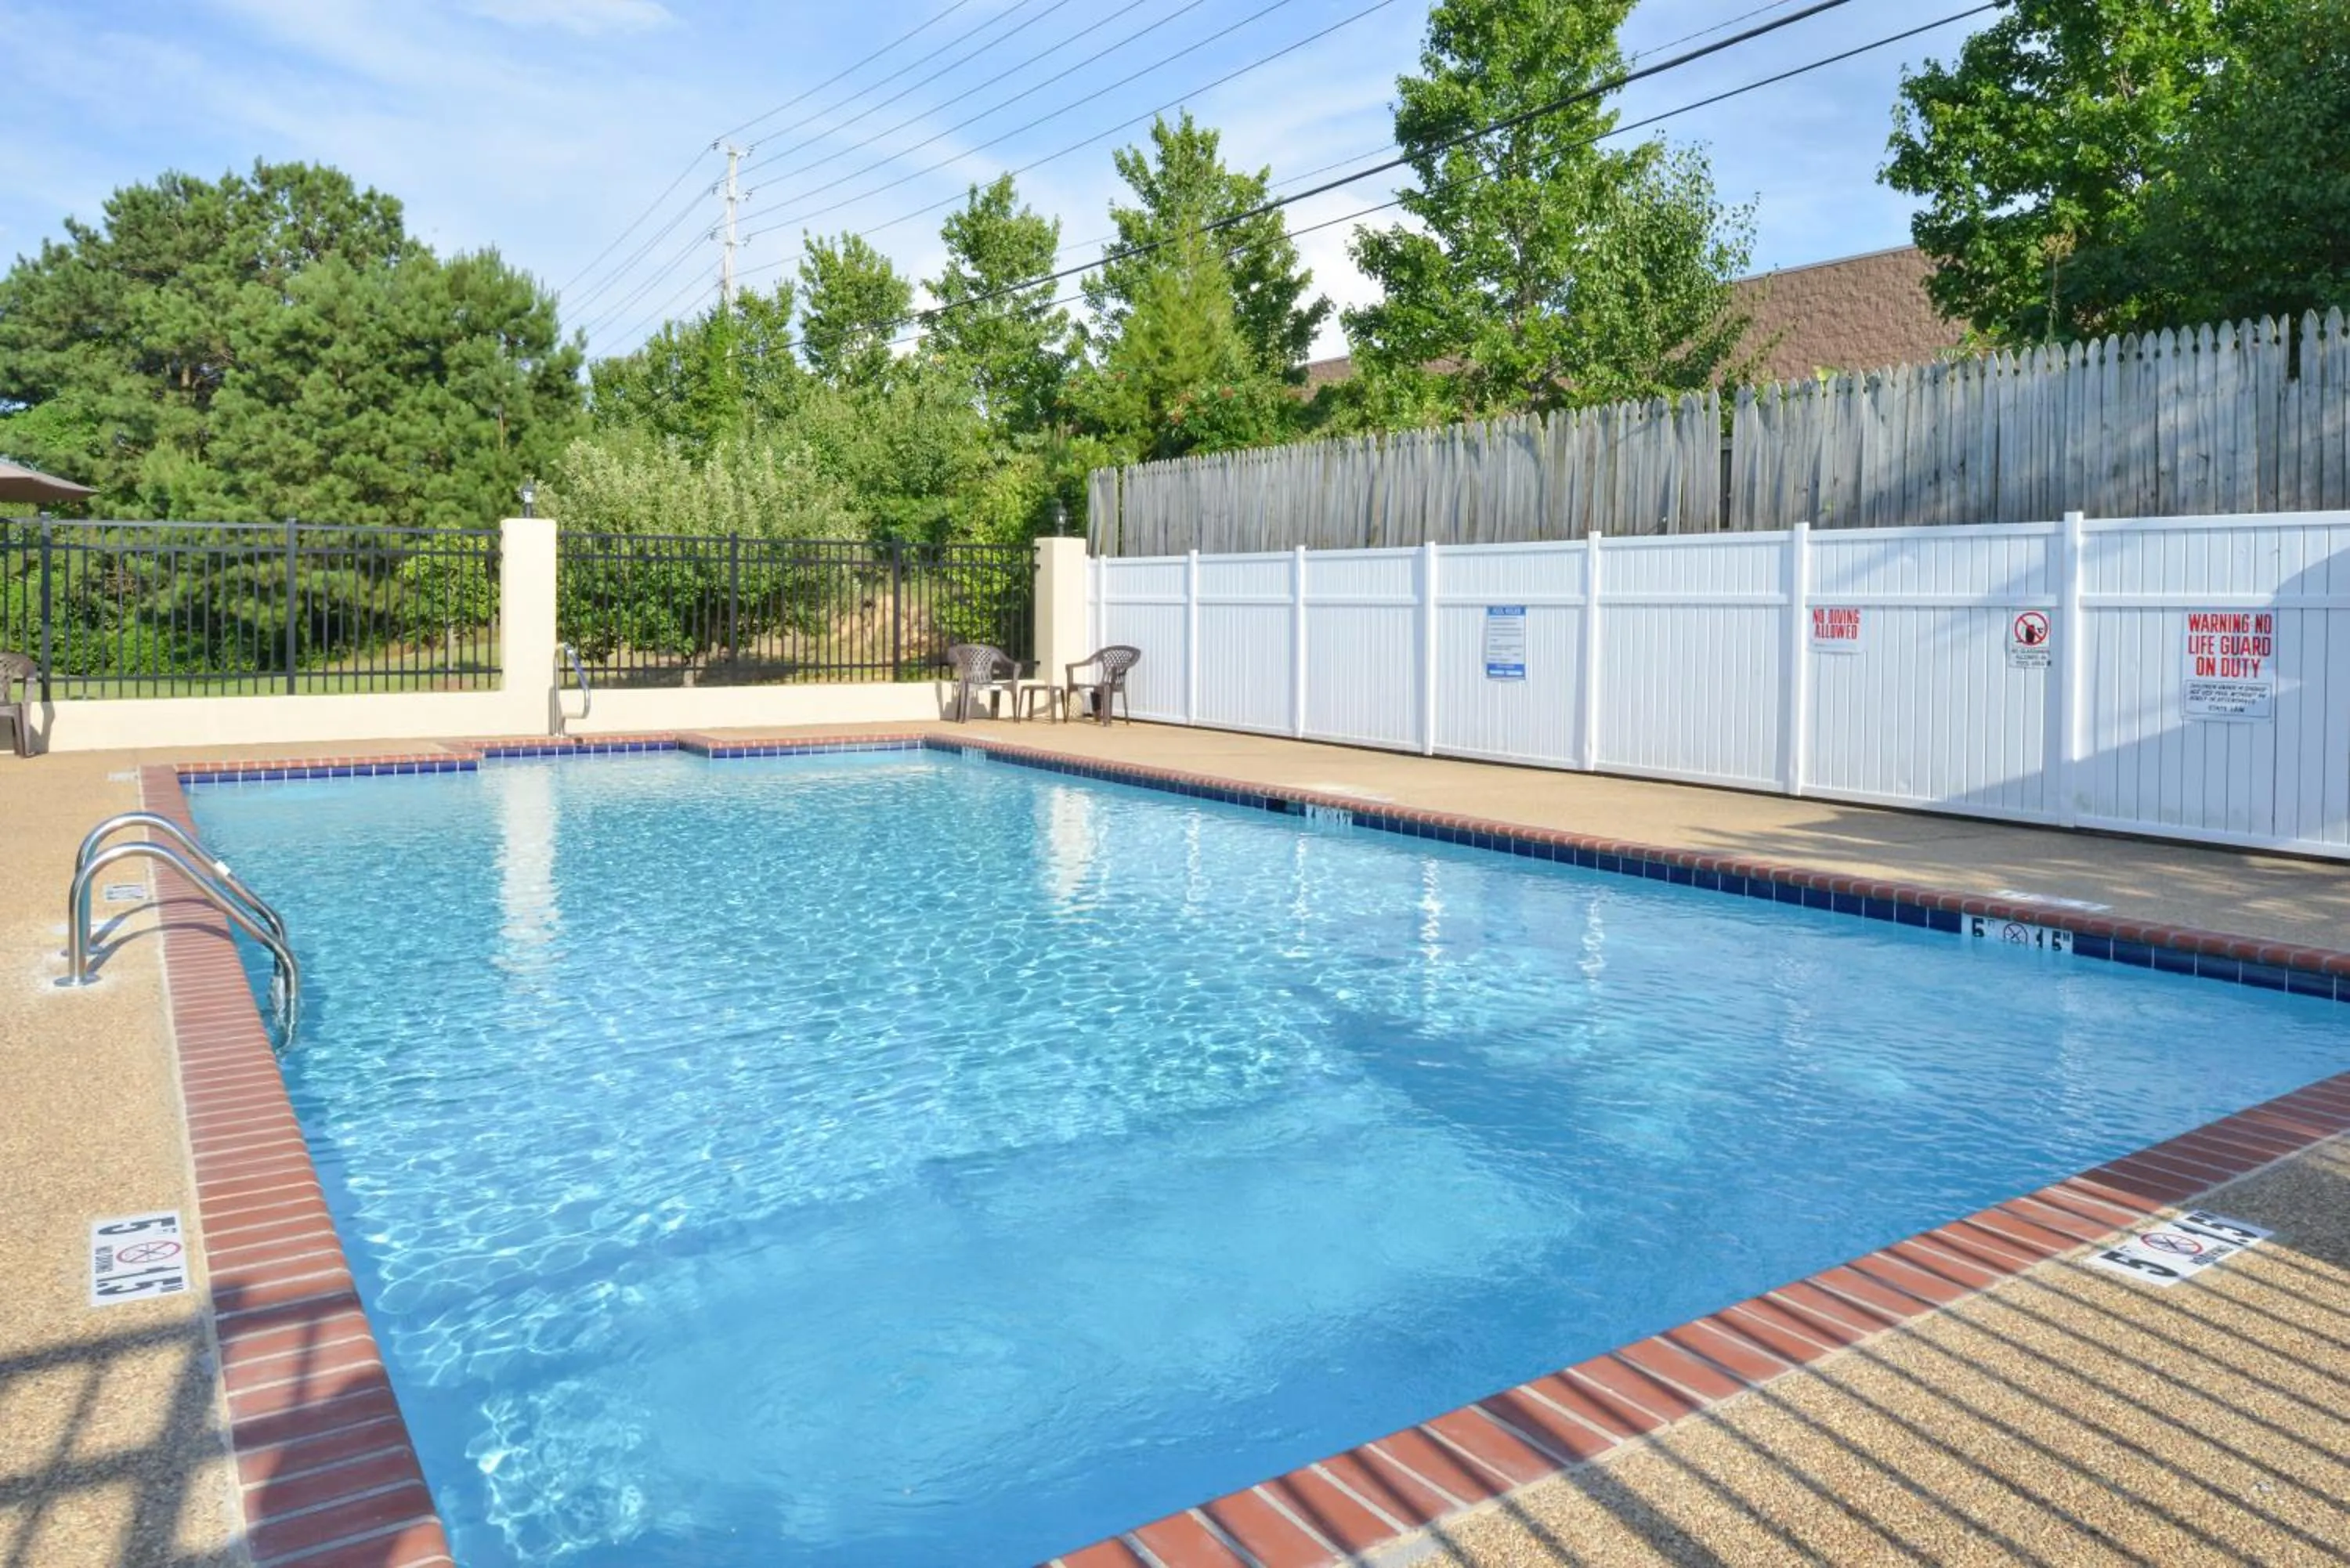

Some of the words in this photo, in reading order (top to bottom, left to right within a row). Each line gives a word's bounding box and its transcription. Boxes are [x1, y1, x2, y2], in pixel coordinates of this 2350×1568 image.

[1813, 608, 1824, 623] NO
[1828, 608, 1860, 623] DIVING
[2188, 613, 2251, 634] WARNING
[2254, 613, 2272, 634] NO
[1814, 624, 1857, 639] ALLOWED
[2188, 635, 2215, 655] LIFE
[2220, 635, 2272, 656] GUARD
[2196, 656, 2216, 677] ON
[2221, 657, 2261, 678] DUTY
